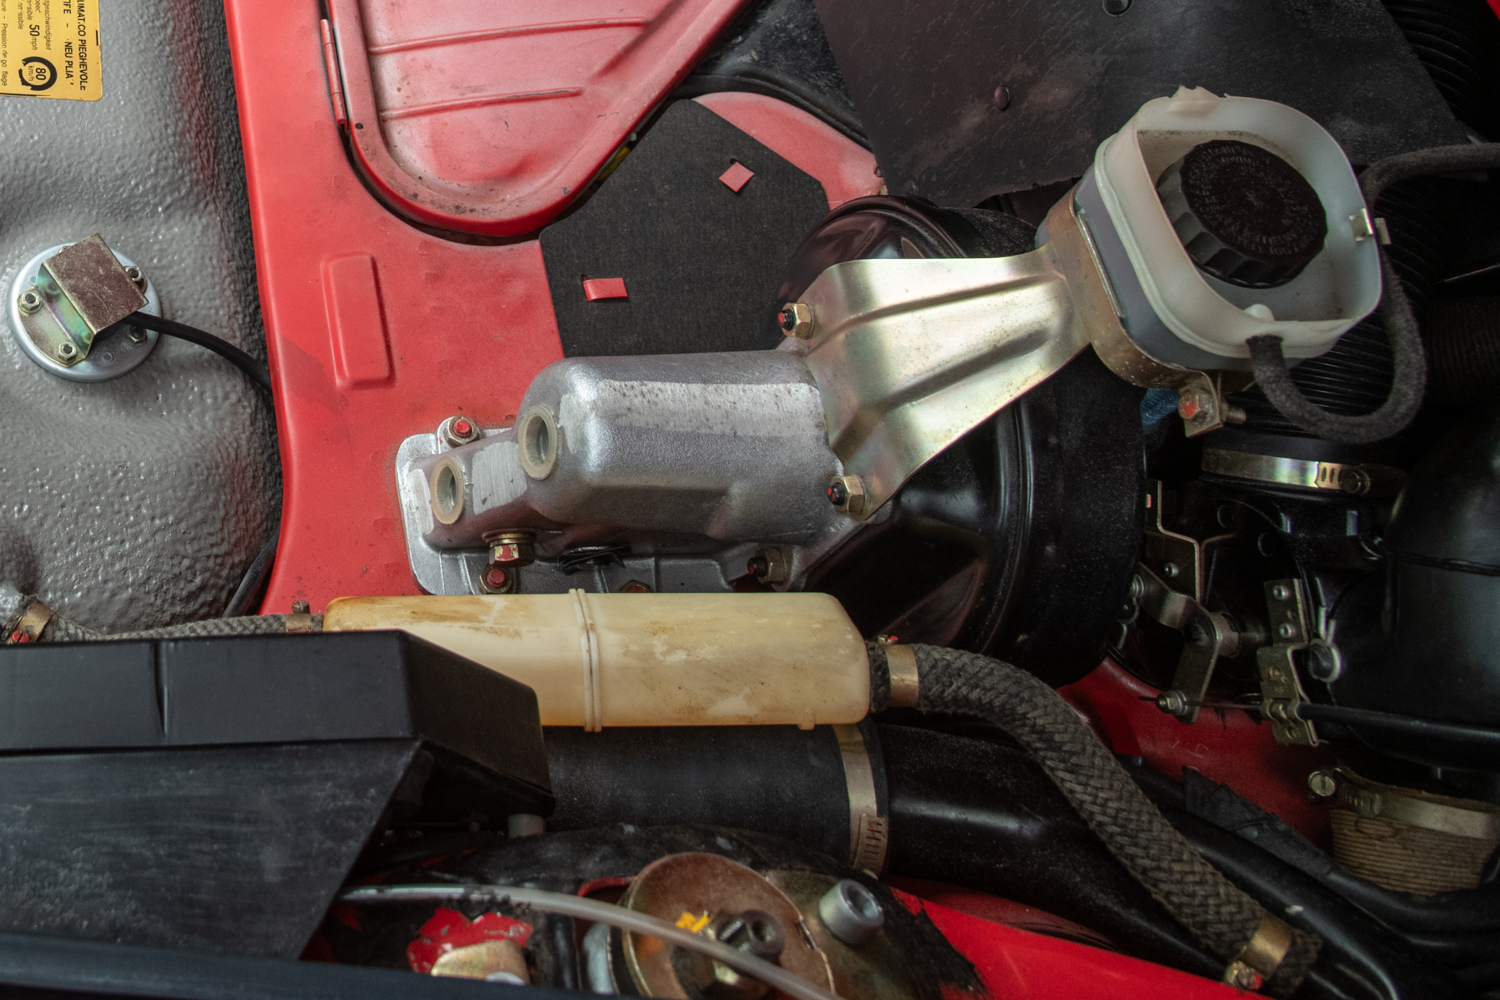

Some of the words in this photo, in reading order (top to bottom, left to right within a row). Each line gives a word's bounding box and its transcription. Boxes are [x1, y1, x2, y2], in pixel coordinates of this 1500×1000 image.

[0, 22, 8, 49] Pression
[28, 23, 40, 36] 50
[30, 36, 38, 50] mph
[27, 64, 35, 81] km/h
[34, 67, 46, 80] 80
